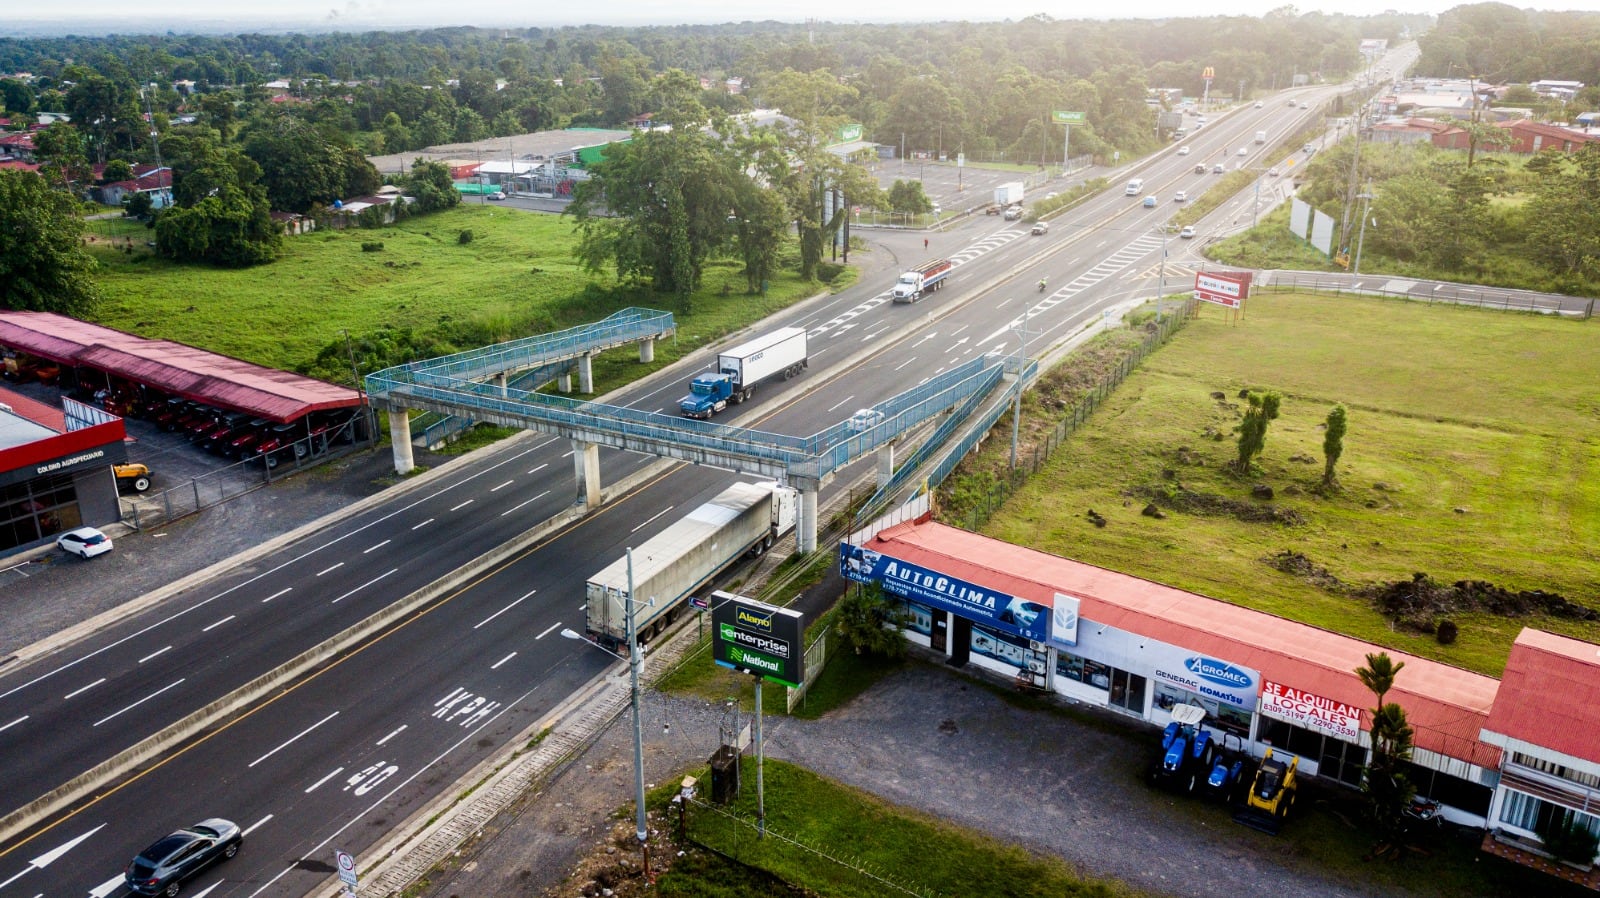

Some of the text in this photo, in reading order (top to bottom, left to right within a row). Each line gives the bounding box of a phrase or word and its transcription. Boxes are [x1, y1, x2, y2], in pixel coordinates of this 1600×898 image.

[37, 450, 104, 474] COLONO AGROPECUARIO
[885, 577, 912, 591] Repuestos
[912, 586, 923, 595] Aire
[923, 590, 963, 608] Acondicionado
[738, 611, 770, 627] Alamo
[725, 628, 788, 653] enterprise
[742, 653, 779, 671] National
[1190, 657, 1248, 685] AGROMEC
[1155, 669, 1197, 688] GENERAC
[431, 687, 501, 728] KPH
[1199, 686, 1243, 705] KOMATSU
[1265, 681, 1361, 718] SE ALQUILAN
[1263, 703, 1305, 721] 8309-5199
[1312, 718, 1357, 737] 2290-3530
[1273, 696, 1348, 727] LOCALES
[342, 760, 399, 796] 40
